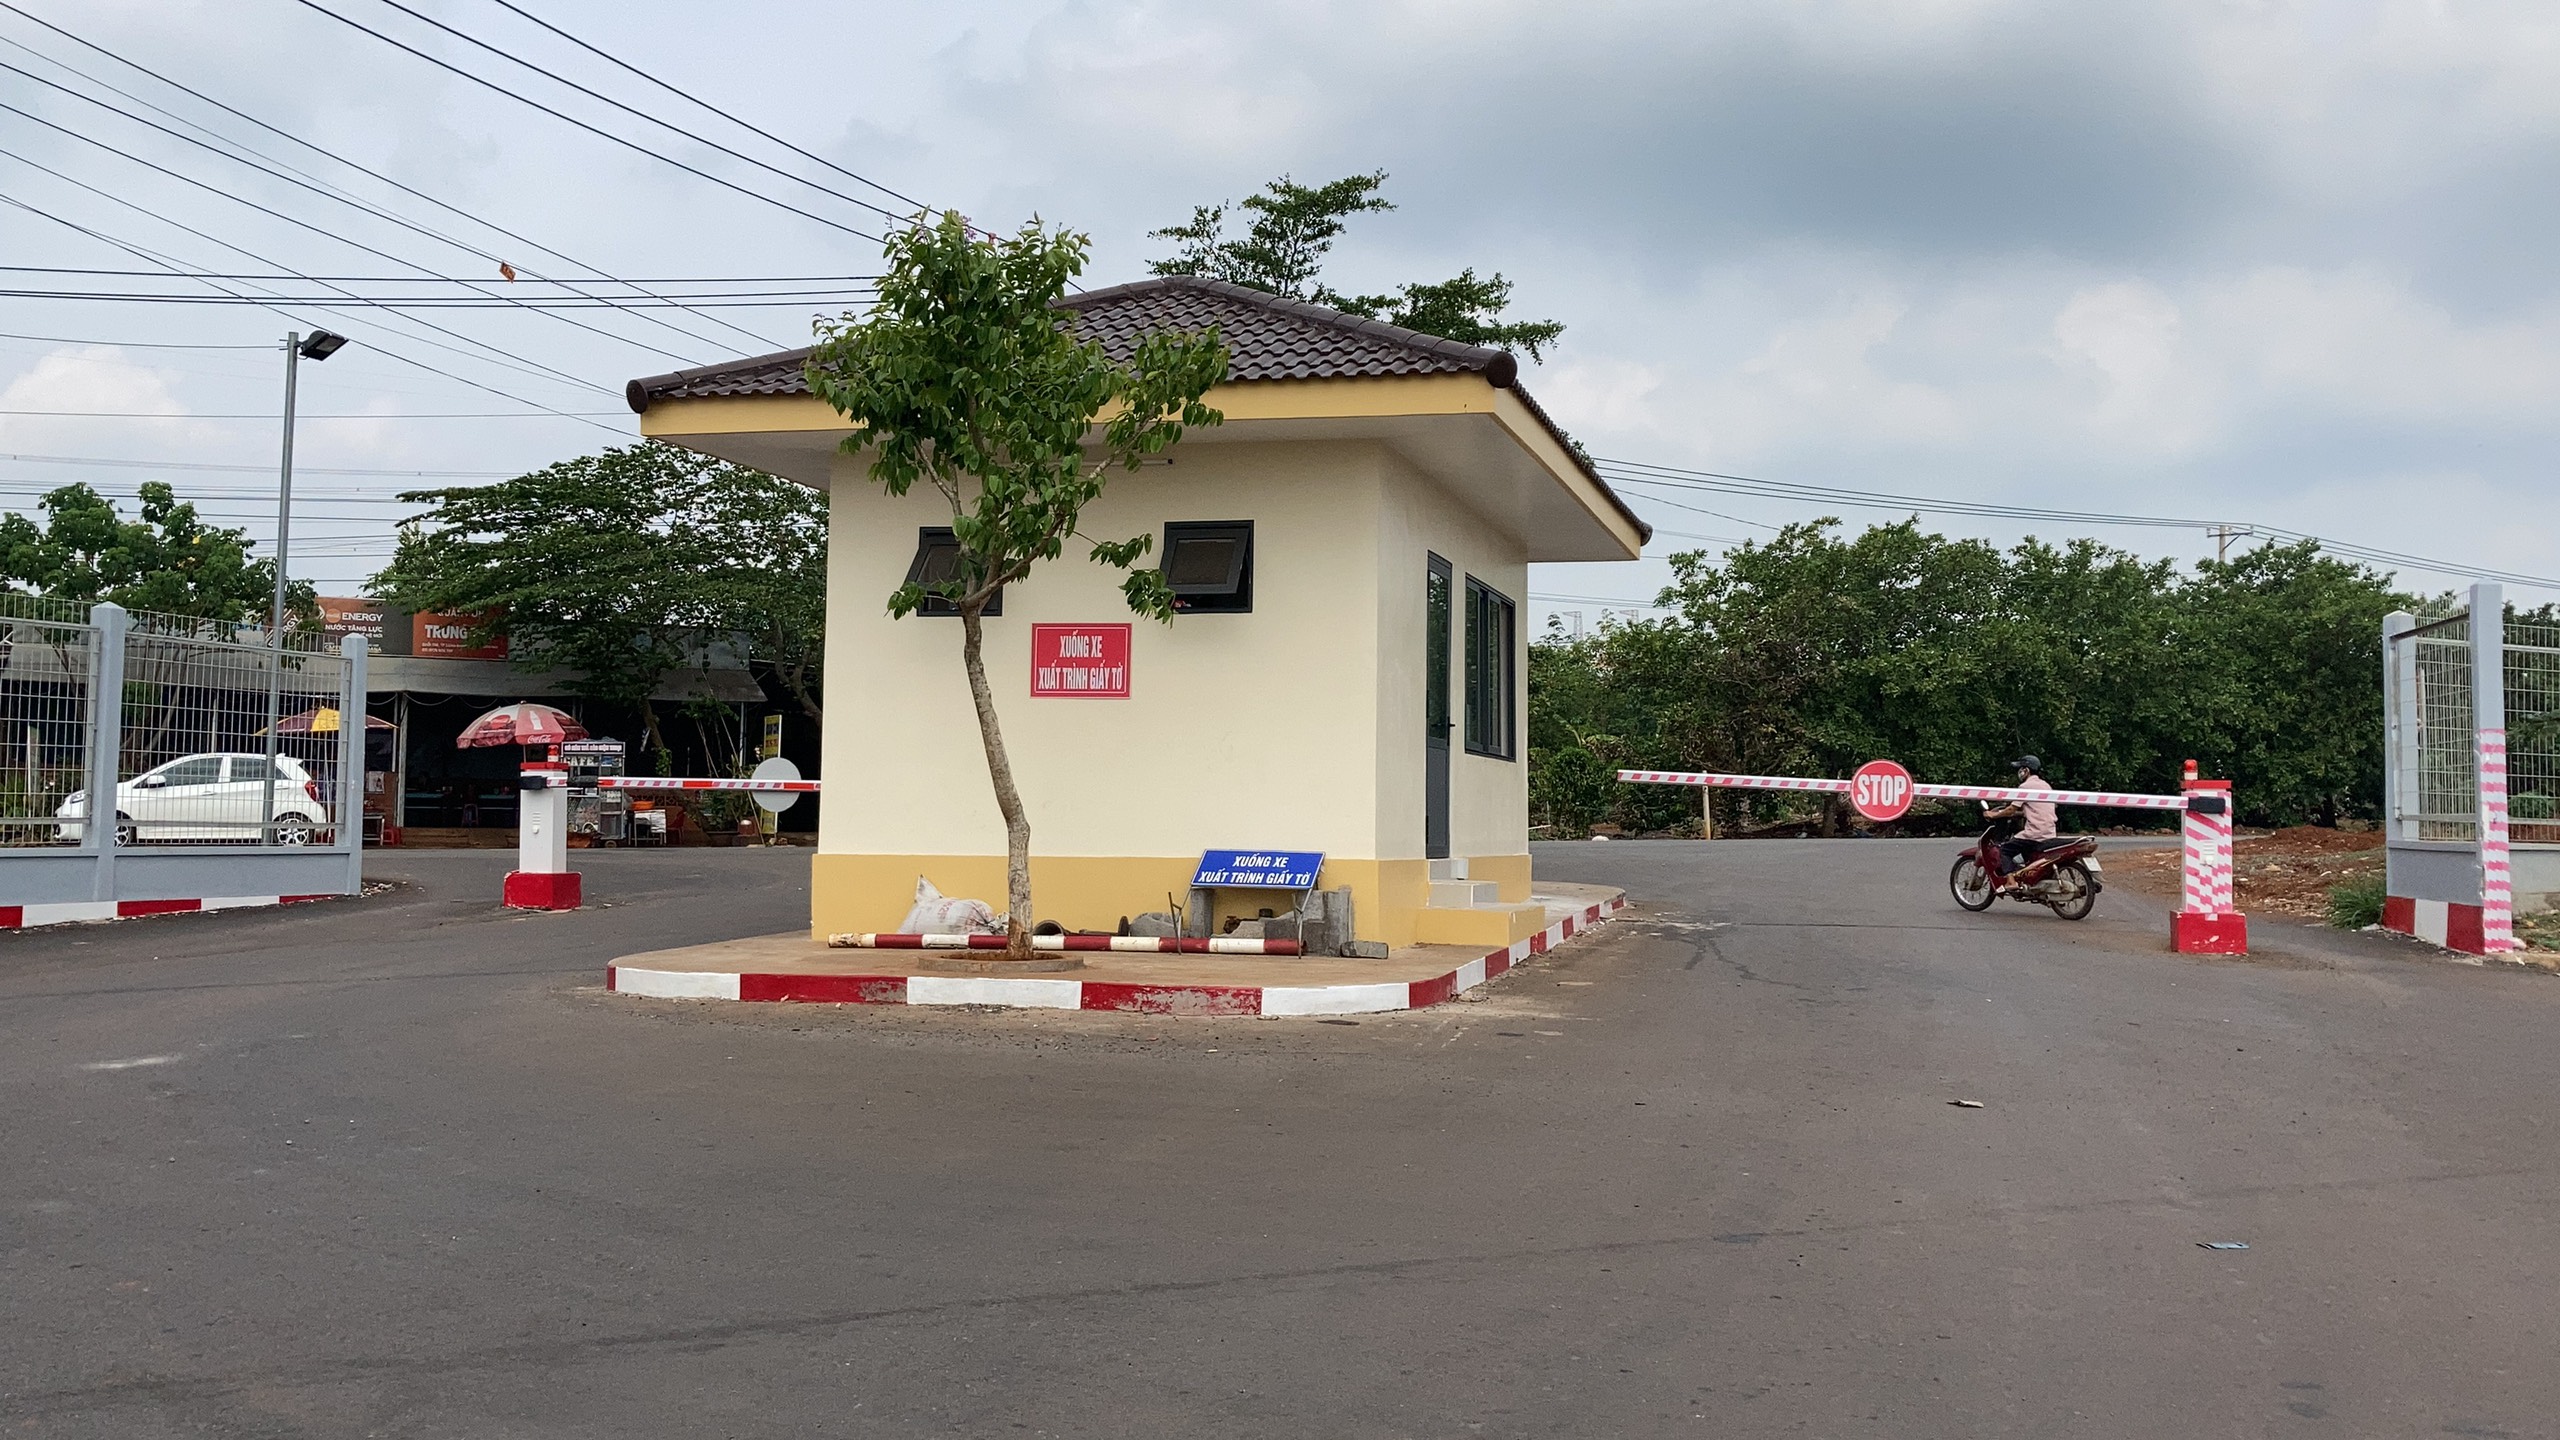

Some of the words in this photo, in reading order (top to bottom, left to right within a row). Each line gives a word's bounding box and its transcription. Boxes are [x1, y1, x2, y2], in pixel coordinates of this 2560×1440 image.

[342, 612, 383, 622] ENERGY
[348, 624, 367, 632] TĂNG
[1059, 630, 1089, 658] XUỐNG
[1090, 635, 1103, 658] XE
[1038, 660, 1061, 690] XUẤT
[1062, 662, 1088, 690] TRÌNH
[1089, 660, 1110, 690] GIẤY
[1111, 662, 1123, 690] TỜ
[1857, 773, 1907, 807] STOP
[1232, 853, 1272, 868] XUỐNG
[1272, 857, 1289, 868] XE
[1198, 868, 1229, 883] XUẤT
[1229, 870, 1266, 884] TRÌNH
[1266, 869, 1294, 885] GIẤY
[1294, 872, 1311, 886] TỜ
